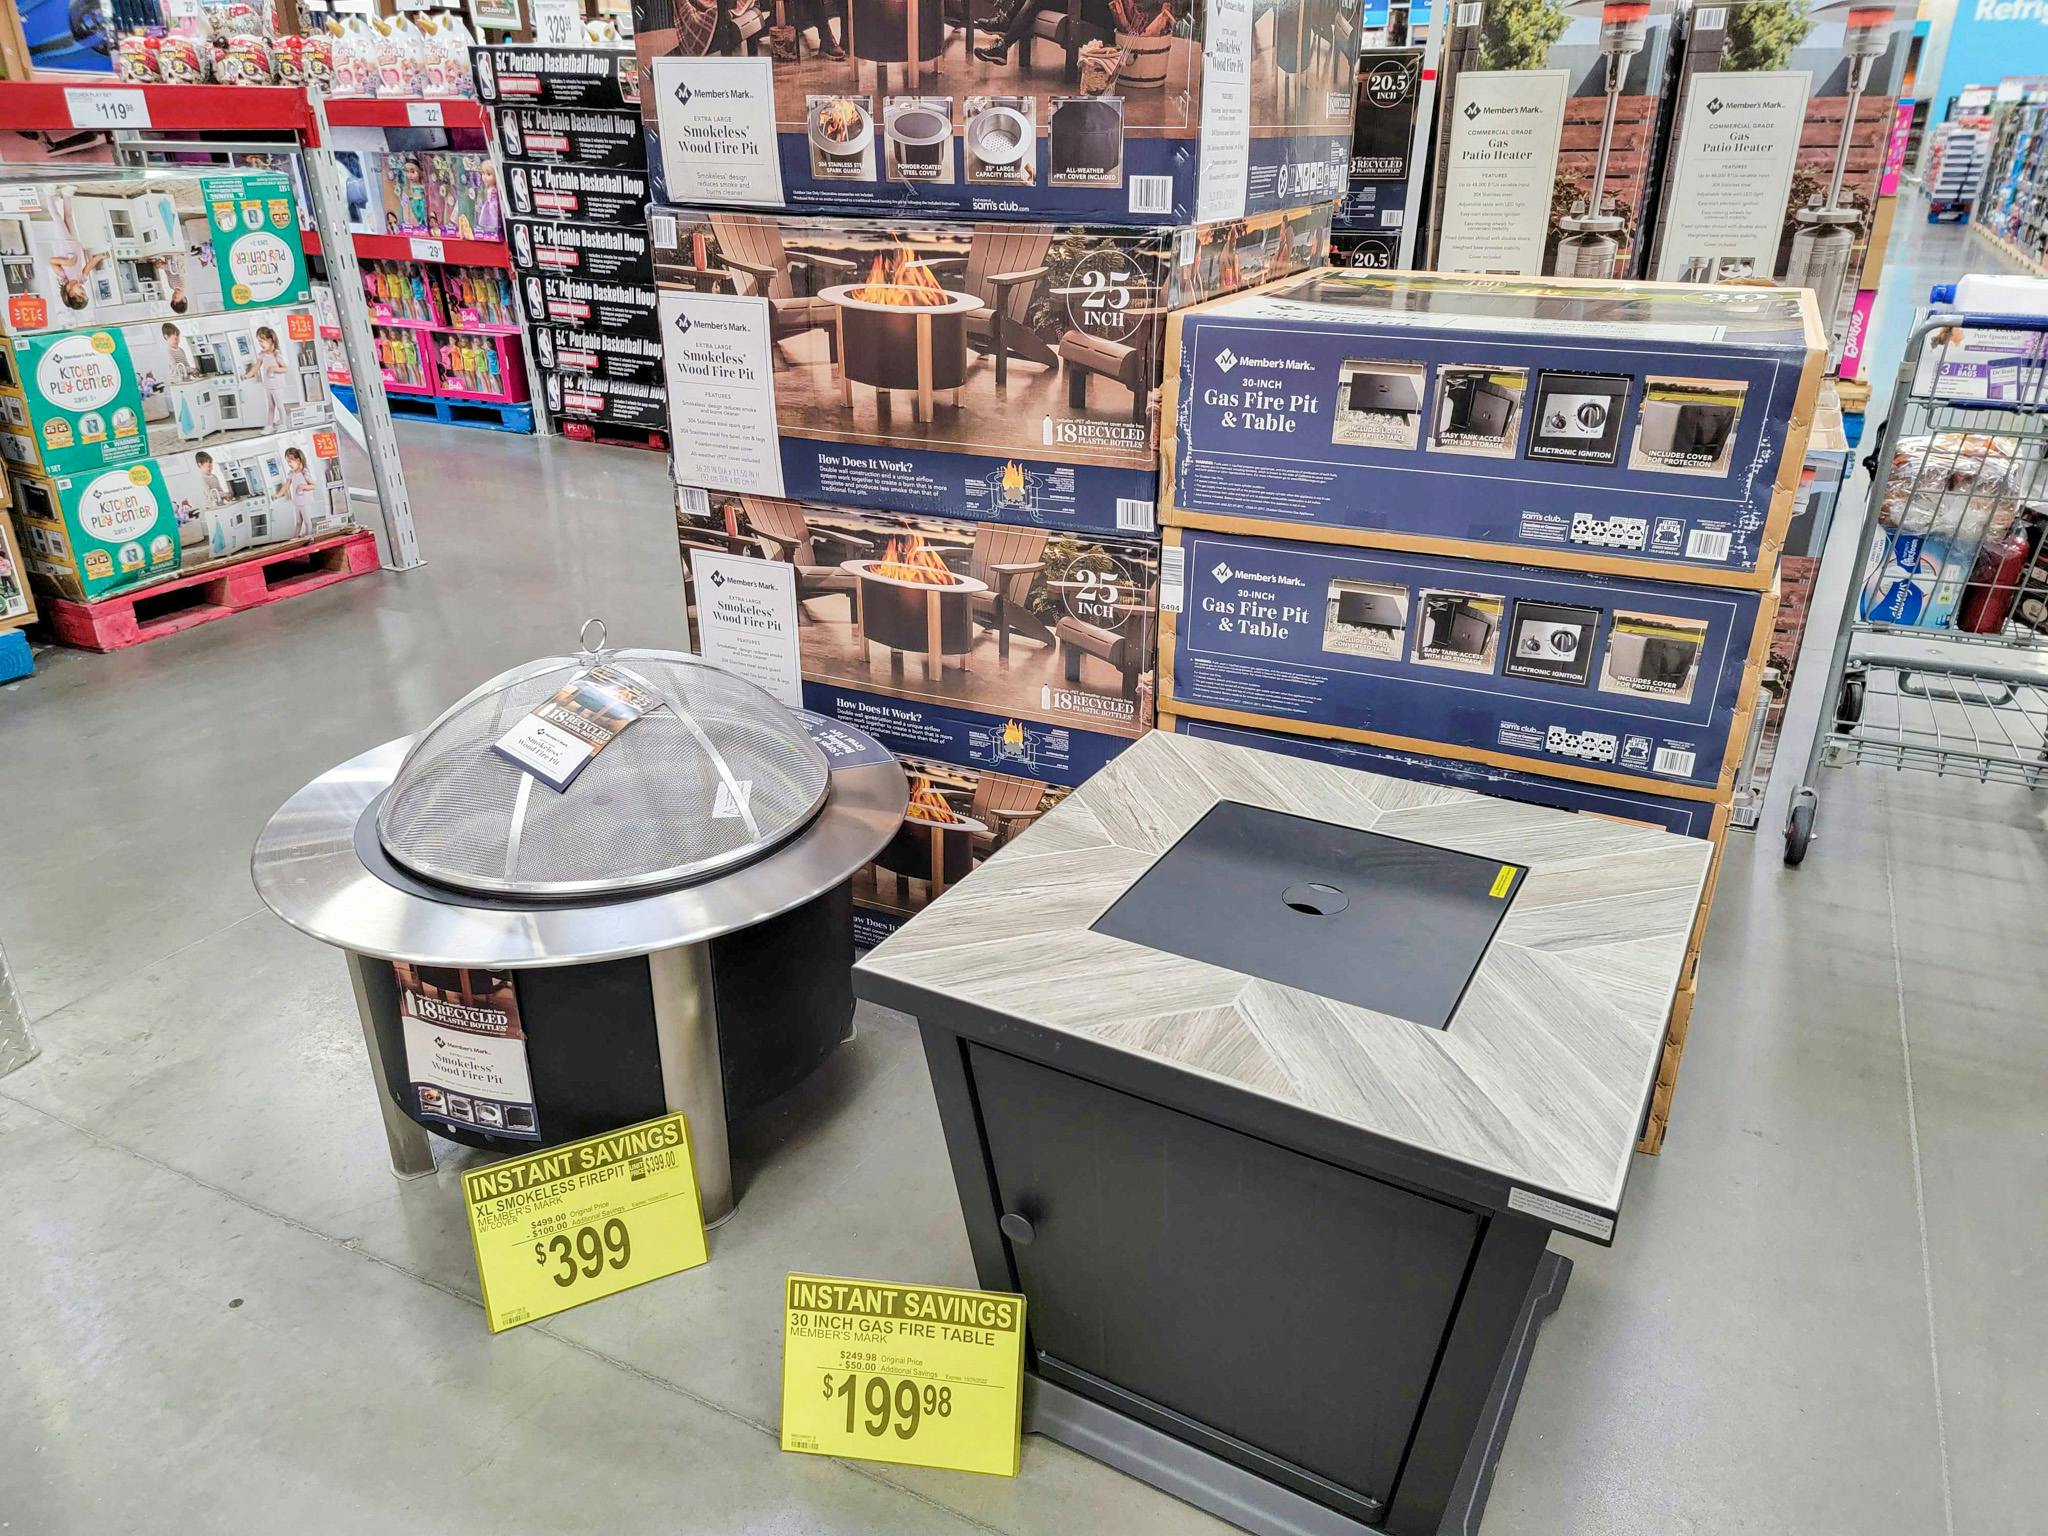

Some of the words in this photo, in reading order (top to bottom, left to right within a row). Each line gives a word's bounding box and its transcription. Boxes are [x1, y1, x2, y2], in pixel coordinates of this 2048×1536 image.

[510, 53, 543, 72] Portable
[545, 54, 586, 74] Basketball
[588, 56, 609, 76] Hoop
[1371, 75, 1406, 91] 20.5
[695, 89, 729, 98] Member's
[730, 90, 750, 98] Mark
[1377, 91, 1397, 100] INCH
[1488, 139, 1508, 148] Gas
[1730, 132, 1750, 141] Gas
[678, 141, 712, 154] Wood
[715, 142, 739, 154] Fire
[741, 143, 759, 155] Pit
[1462, 150, 1491, 160] Patio
[1494, 150, 1533, 160] Heater
[1703, 142, 1732, 152] Patio
[1735, 143, 1773, 152] Heater
[546, 172, 578, 190] Portable
[580, 173, 622, 194] Basketball
[624, 177, 644, 197] Hoop
[973, 202, 997, 211] sam's
[1355, 253, 1388, 267] 20.5
[1082, 271, 1130, 308] 25
[694, 320, 727, 330] Member's
[729, 321, 747, 331] Mark
[1084, 311, 1124, 326] INCH
[1240, 356, 1284, 368] Member's
[1286, 360, 1310, 370] Mark
[678, 363, 711, 376] Wood
[713, 364, 735, 378] Fire
[739, 366, 754, 380] Pit
[1242, 378, 1282, 389] 30-INCH
[1204, 389, 1239, 406] Gas
[1245, 391, 1284, 410] Fire
[1289, 395, 1319, 414] Pit
[1221, 412, 1237, 428] &
[1242, 413, 1296, 432] Table
[1056, 424, 1077, 443] 18
[1079, 425, 1144, 440] RECYCLED
[1078, 437, 1109, 445] PLASTIC
[1480, 435, 1505, 443] ACCESS
[1472, 440, 1503, 449] STORAGE
[1534, 447, 1577, 456] ELECTRONIC
[1578, 450, 1611, 459] IGNITION
[1649, 450, 1685, 459] INCLUDES
[1687, 453, 1713, 461] COVER
[818, 454, 840, 465] How
[843, 457, 867, 468] Does
[869, 459, 877, 470] It
[879, 460, 913, 472] Work?
[1664, 458, 1711, 468] PROTECTION
[820, 465, 837, 473] Double
[850, 469, 880, 478] construction
[897, 473, 915, 481] unique
[916, 475, 933, 483] airflow
[1522, 513, 1542, 521] sam's
[727, 577, 757, 588] Member's
[758, 582, 775, 591] Mark
[1076, 569, 1119, 603] 25
[1235, 570, 1276, 583] Member's
[1278, 576, 1300, 586] Mark
[1238, 589, 1275, 600] 30-INCH
[1078, 602, 1114, 618] INCH
[1202, 597, 1234, 614] Gas
[1240, 601, 1278, 620] Fire
[1282, 606, 1309, 624] Pit
[713, 611, 740, 625] Wood
[744, 617, 764, 628] Fire
[768, 621, 782, 631] Pit
[1219, 617, 1233, 632] &
[1238, 619, 1289, 640] Table
[417, 999, 438, 1019] 18
[438, 1005, 508, 1025] RECYCLED
[439, 1014, 468, 1026] PLASTIC
[472, 1153, 573, 1201] INSTANT
[580, 1123, 679, 1167] SAVINGS
[645, 1151, 676, 1173] $399.00
[630, 1168, 645, 1177] PRICE
[475, 1204, 494, 1218] XL
[496, 1179, 576, 1212] SMOKELESS
[579, 1165, 625, 1189] FIREPIT
[478, 1206, 532, 1226] MEMBER'S
[534, 1197, 563, 1210] MARK
[531, 1213, 566, 1229] $499.00
[570, 1205, 593, 1218] Original
[594, 1201, 610, 1211] Price
[572, 1212, 601, 1226] Additional
[602, 1205, 625, 1217] Savings
[479, 1225, 489, 1233] W/
[491, 1217, 519, 1229] COVER
[534, 1217, 631, 1287] $399
[793, 1283, 898, 1315] INSTANT
[904, 1292, 1012, 1329] SAVINGS
[790, 1328, 850, 1341] MEMBER'S
[854, 1333, 888, 1344] MARK
[791, 1313, 809, 1326] 30
[814, 1315, 853, 1331] INCH
[859, 1319, 893, 1334] GAS
[900, 1323, 936, 1339] FIRE
[941, 1327, 995, 1346] TABLE
[840, 1350, 877, 1362] $249.98
[881, 1356, 905, 1365] Original
[907, 1358, 923, 1366] Price
[880, 1365, 911, 1375] Additional
[913, 1369, 938, 1379] Savings
